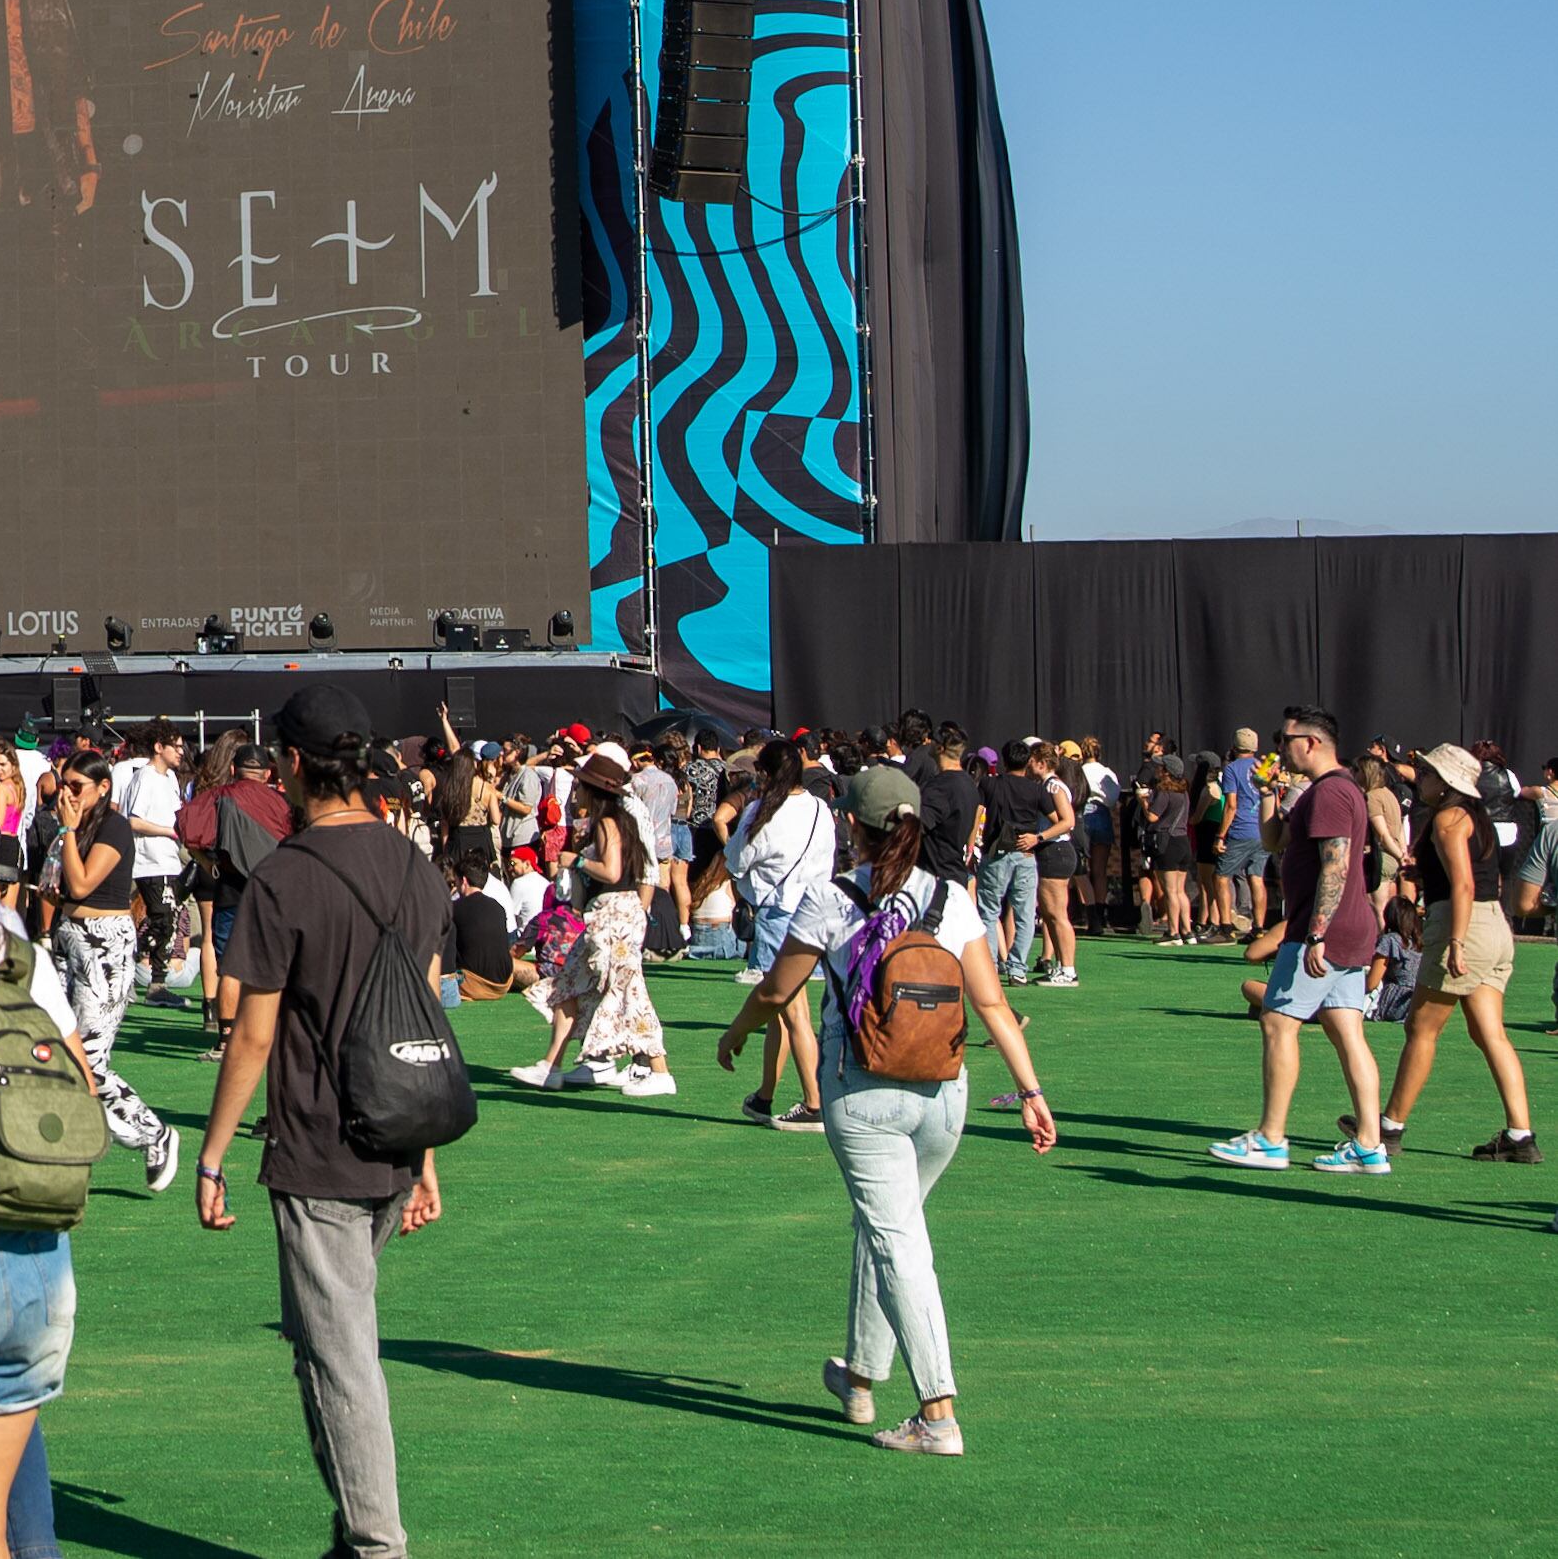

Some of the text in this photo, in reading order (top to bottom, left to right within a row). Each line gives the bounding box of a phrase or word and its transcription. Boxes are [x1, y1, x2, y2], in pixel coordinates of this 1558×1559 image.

[144, 3, 295, 82] Santiago
[309, 5, 347, 49] de
[331, 64, 416, 131] Arena
[246, 352, 392, 379] TOUR
[231, 604, 303, 622] PUNTO
[369, 607, 400, 617] MEDIA
[7, 610, 79, 636] LOTUS
[141, 617, 200, 629] ENTRADAS
[231, 622, 305, 637] TICKET
[369, 618, 417, 628] PARTNER:
